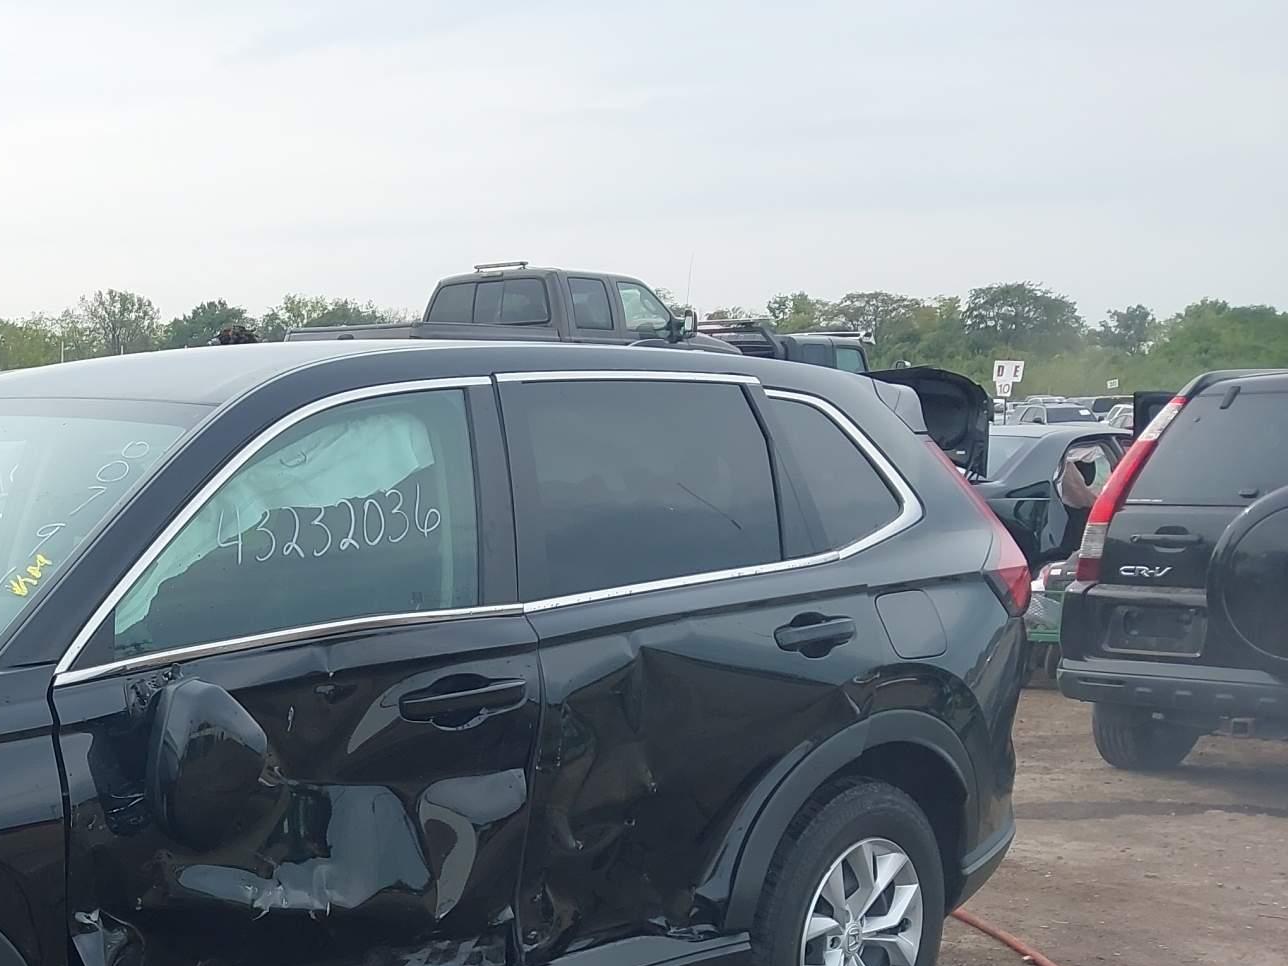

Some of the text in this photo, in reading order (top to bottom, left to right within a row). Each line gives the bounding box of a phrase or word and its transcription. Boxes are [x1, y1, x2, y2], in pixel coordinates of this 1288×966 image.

[998, 383, 1011, 395] 10
[217, 483, 441, 564] 43232036
[1119, 566, 1173, 578] CR-V
